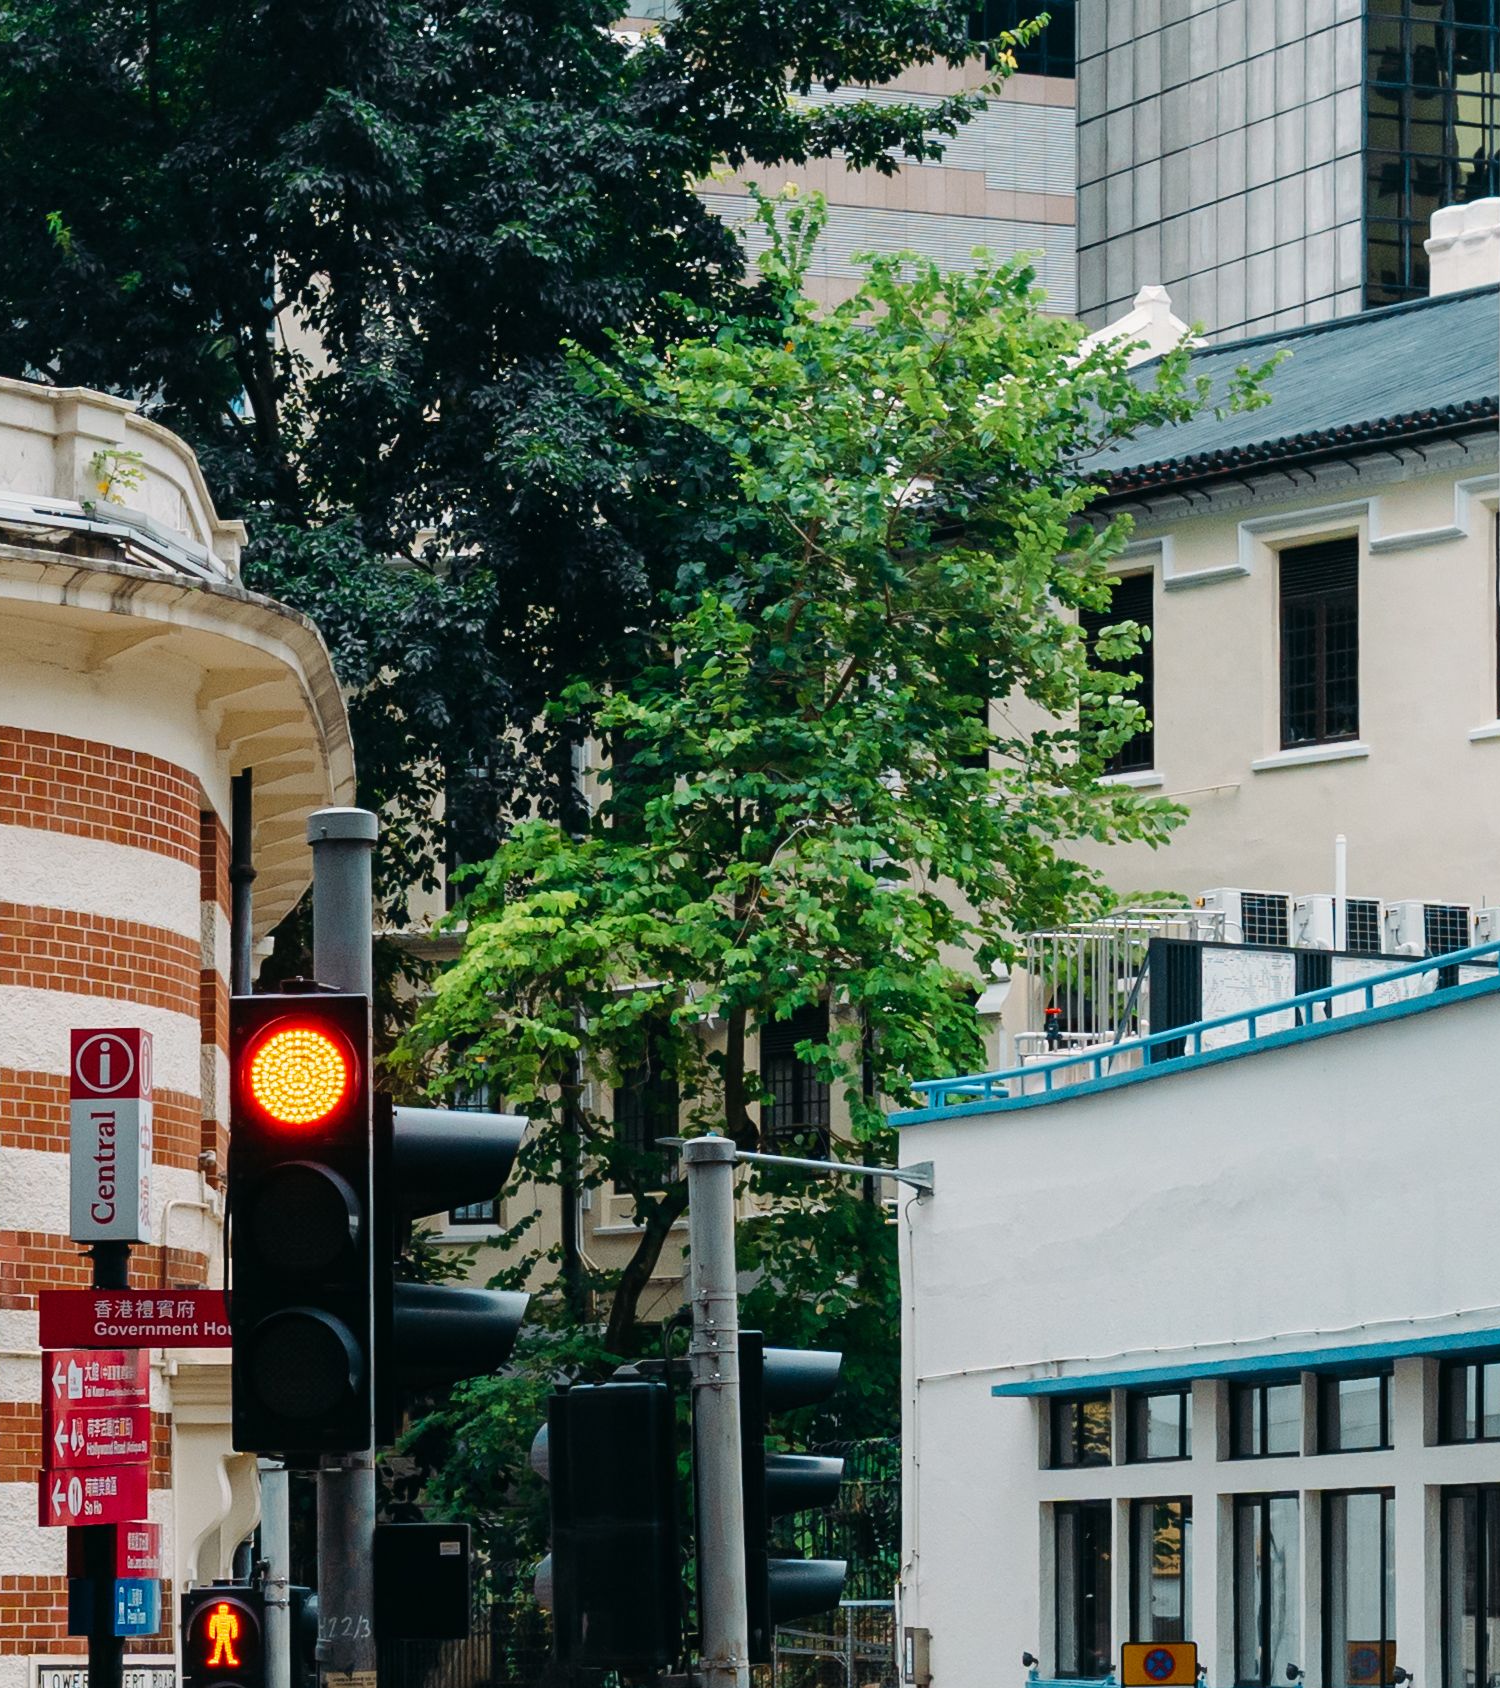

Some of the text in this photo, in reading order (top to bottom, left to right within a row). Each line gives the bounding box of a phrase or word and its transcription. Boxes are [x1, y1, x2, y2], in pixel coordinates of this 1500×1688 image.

[90, 1111, 116, 1225] Central
[94, 1299, 196, 1319] 香港禮賓府
[94, 1322, 198, 1336] Government
